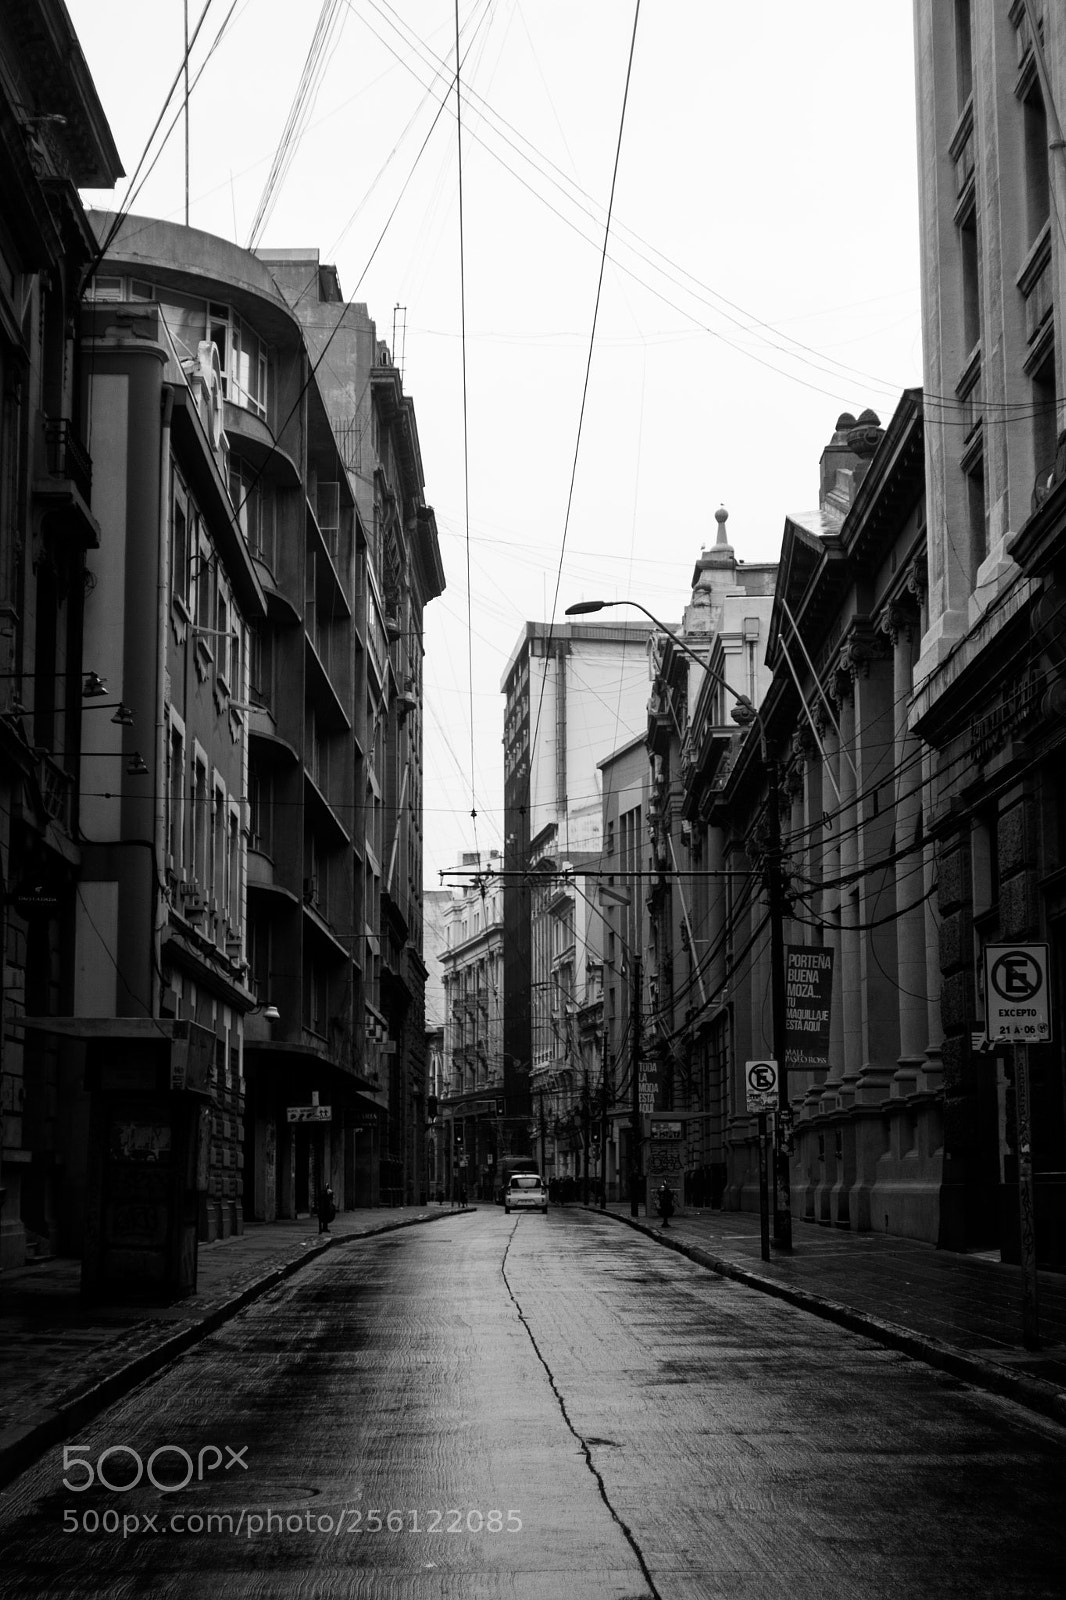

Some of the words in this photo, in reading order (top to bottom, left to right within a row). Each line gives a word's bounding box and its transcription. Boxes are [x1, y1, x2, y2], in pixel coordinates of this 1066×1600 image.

[788, 953, 831, 969] PORTEÑA
[788, 969, 819, 983] BUENA
[786, 997, 796, 1007] TU
[785, 1008, 830, 1021] MAQUILLAJE
[999, 1009, 1037, 1017] EXCEPTO
[1000, 1026, 1010, 1034] 21
[637, 1062, 657, 1072] TODA
[638, 1072, 647, 1082] LA
[638, 1083, 659, 1093] MODA
